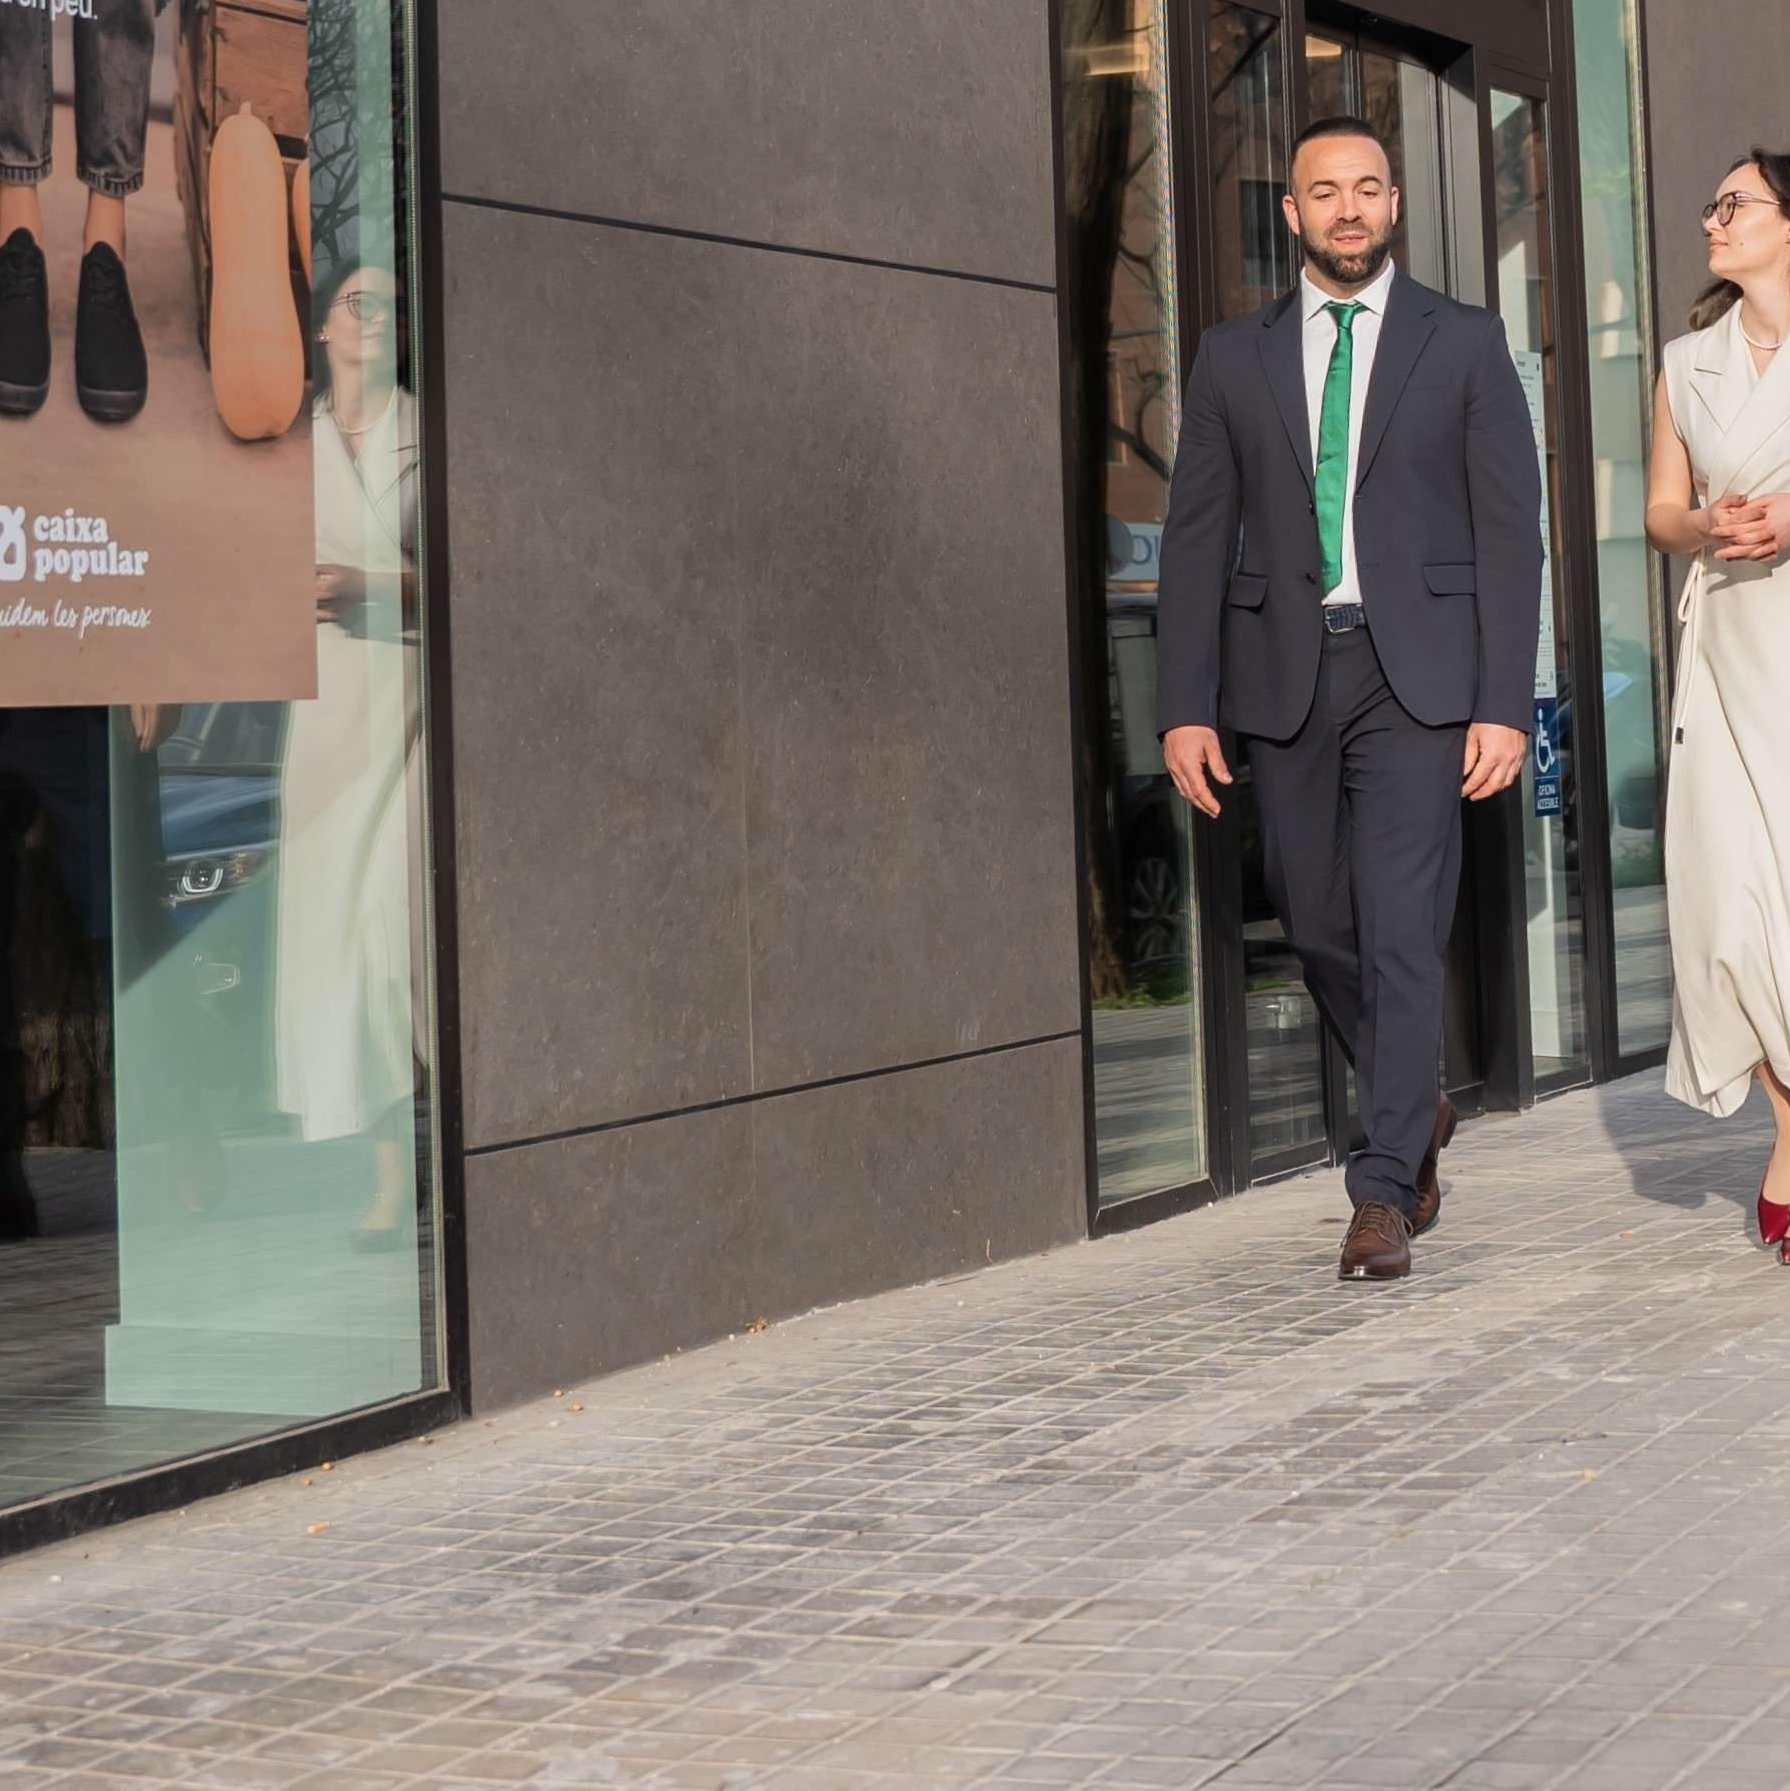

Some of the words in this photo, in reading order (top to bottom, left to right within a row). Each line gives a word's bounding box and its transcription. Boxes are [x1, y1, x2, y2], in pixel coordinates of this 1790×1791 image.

[33, 507, 109, 544] caixa
[33, 541, 149, 583] popular
[53, 599, 78, 629] les
